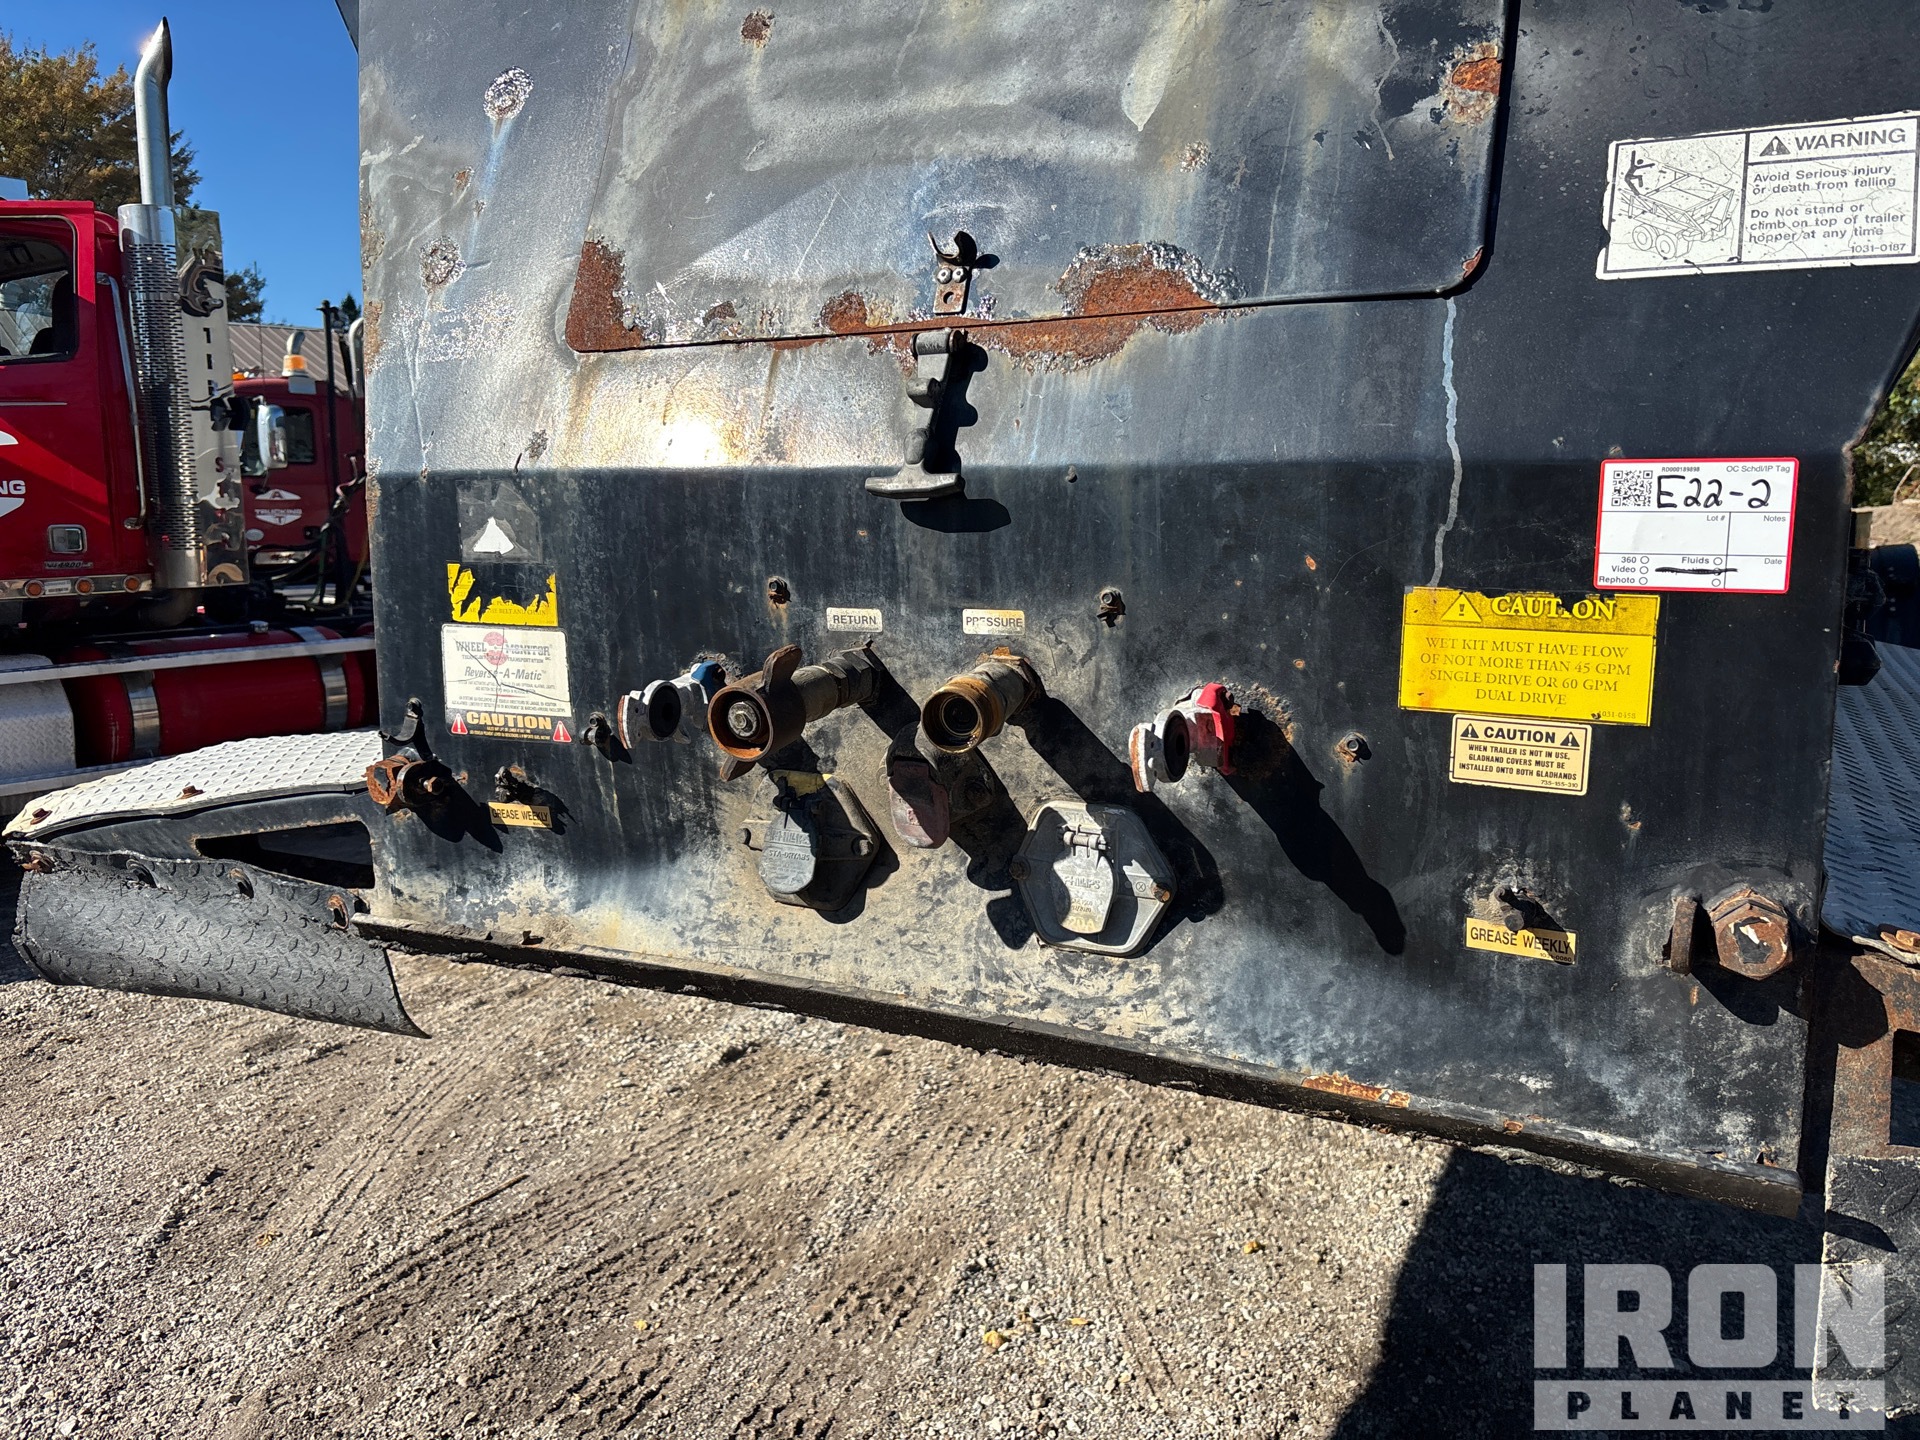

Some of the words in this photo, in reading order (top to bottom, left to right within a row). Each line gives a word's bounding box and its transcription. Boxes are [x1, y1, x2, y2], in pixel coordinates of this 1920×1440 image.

[1795, 128, 1906, 150] WARNING
[1753, 172, 1789, 182] Avoid
[1796, 169, 1847, 179] Serious
[1854, 165, 1892, 176] injury
[1753, 186, 1766, 195] or
[1772, 182, 1810, 193] death
[1817, 180, 1848, 189] from
[1855, 177, 1896, 188] falling
[1751, 209, 1768, 218] Do
[1775, 207, 1798, 217] Not
[1805, 204, 1843, 215] stand
[1850, 204, 1864, 212] or
[1750, 219, 1785, 230] climb
[1792, 220, 1808, 228] on
[1815, 217, 1837, 227] top
[1844, 215, 1858, 224] of
[1865, 213, 1905, 223] trailer
[1749, 232, 1797, 243] hopper
[1803, 230, 1816, 239] at
[1822, 229, 1847, 239] any
[1853, 226, 1883, 236] time
[1851, 243, 1905, 253] 1031-0187
[1657, 475, 1771, 508] E22-2
[1621, 556, 1637, 564] 360
[1611, 565, 1636, 573] Video
[1599, 576, 1635, 584] Rephoto
[833, 615, 876, 625] RETURN
[455, 641, 487, 652] WHEEL
[1426, 637, 1458, 649] WET
[1463, 639, 1488, 650] KIT
[1492, 640, 1534, 653] MUST
[1539, 643, 1578, 655] HAVE
[1583, 645, 1629, 658] FLOW
[1420, 655, 1439, 665] OF
[1443, 655, 1475, 666] NOT
[1479, 657, 1523, 669] MORE
[1528, 660, 1570, 672] THAN
[1575, 663, 1590, 673] 45
[1595, 663, 1631, 676] GPM
[1429, 670, 1482, 683] SINGLE
[1486, 673, 1532, 686] DRIVE
[1536, 677, 1557, 688] OR
[1562, 678, 1578, 689] 60
[1583, 679, 1618, 691] GPM
[1476, 689, 1516, 702] DUAL
[1520, 692, 1566, 705] DRIVE
[466, 711, 552, 730] CAUTION
[1484, 726, 1555, 744] CAUTION
[1468, 744, 1487, 752] WHEN
[1490, 746, 1517, 755] TRAILER
[1519, 748, 1527, 756] IS
[1529, 749, 1543, 757] NOT
[1555, 752, 1570, 760] USE,
[1468, 753, 1504, 763] GLADHAND
[1506, 757, 1532, 766] COVERS
[1535, 760, 1554, 768] MUST
[1556, 761, 1565, 769] BE
[1459, 763, 1493, 772] INSTALLED
[1496, 766, 1513, 774] ONTO
[1516, 768, 1534, 777] BOTH
[1536, 770, 1577, 780] GLADHANDS
[492, 808, 519, 820] GREASE
[521, 810, 548, 821] WEEKLY
[1471, 927, 1517, 946] GREASE
[1523, 935, 1571, 954] WEEKLY
